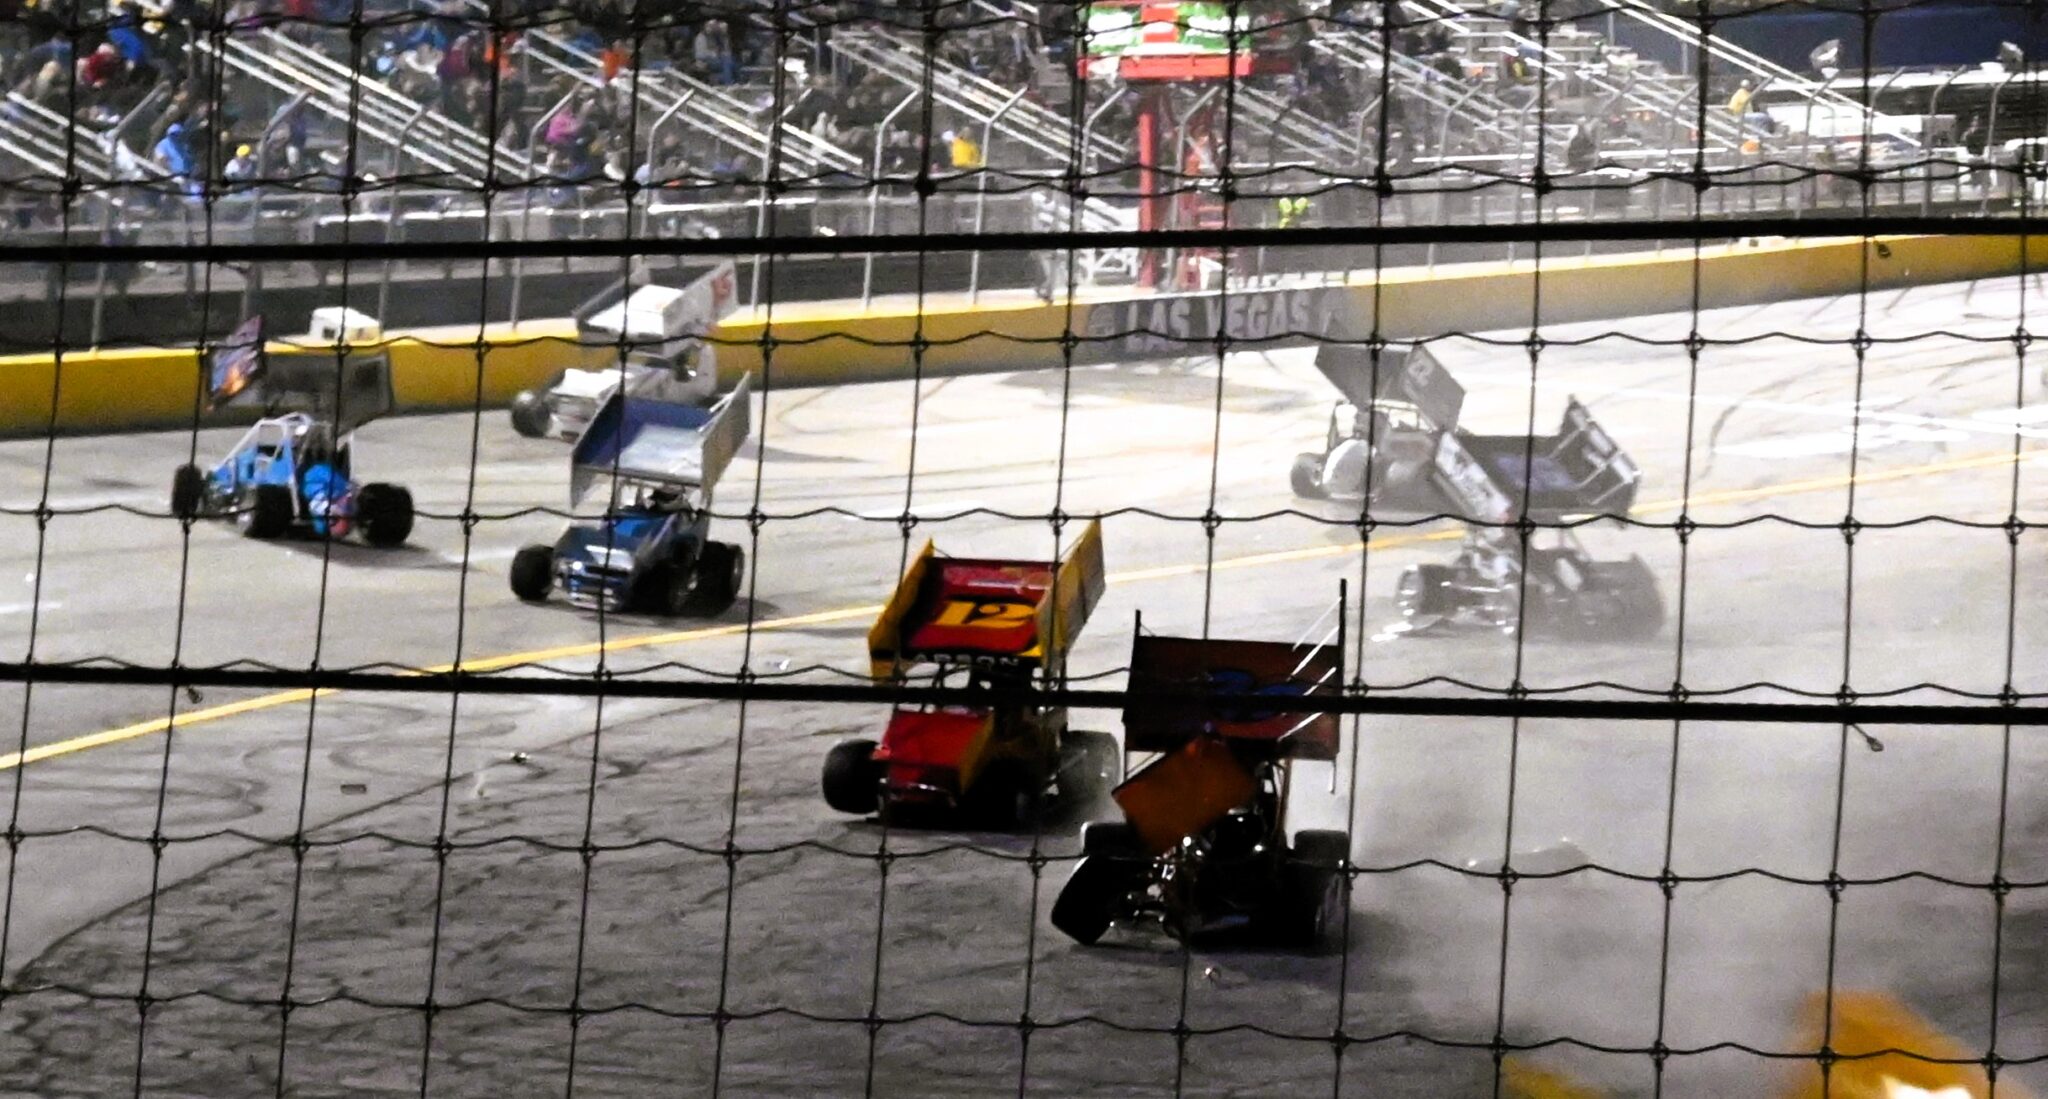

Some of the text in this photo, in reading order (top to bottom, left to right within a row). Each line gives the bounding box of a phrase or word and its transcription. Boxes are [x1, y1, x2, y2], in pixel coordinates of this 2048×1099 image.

[1126, 289, 1310, 351] LAS VEGAS
[935, 600, 1038, 629] 12
